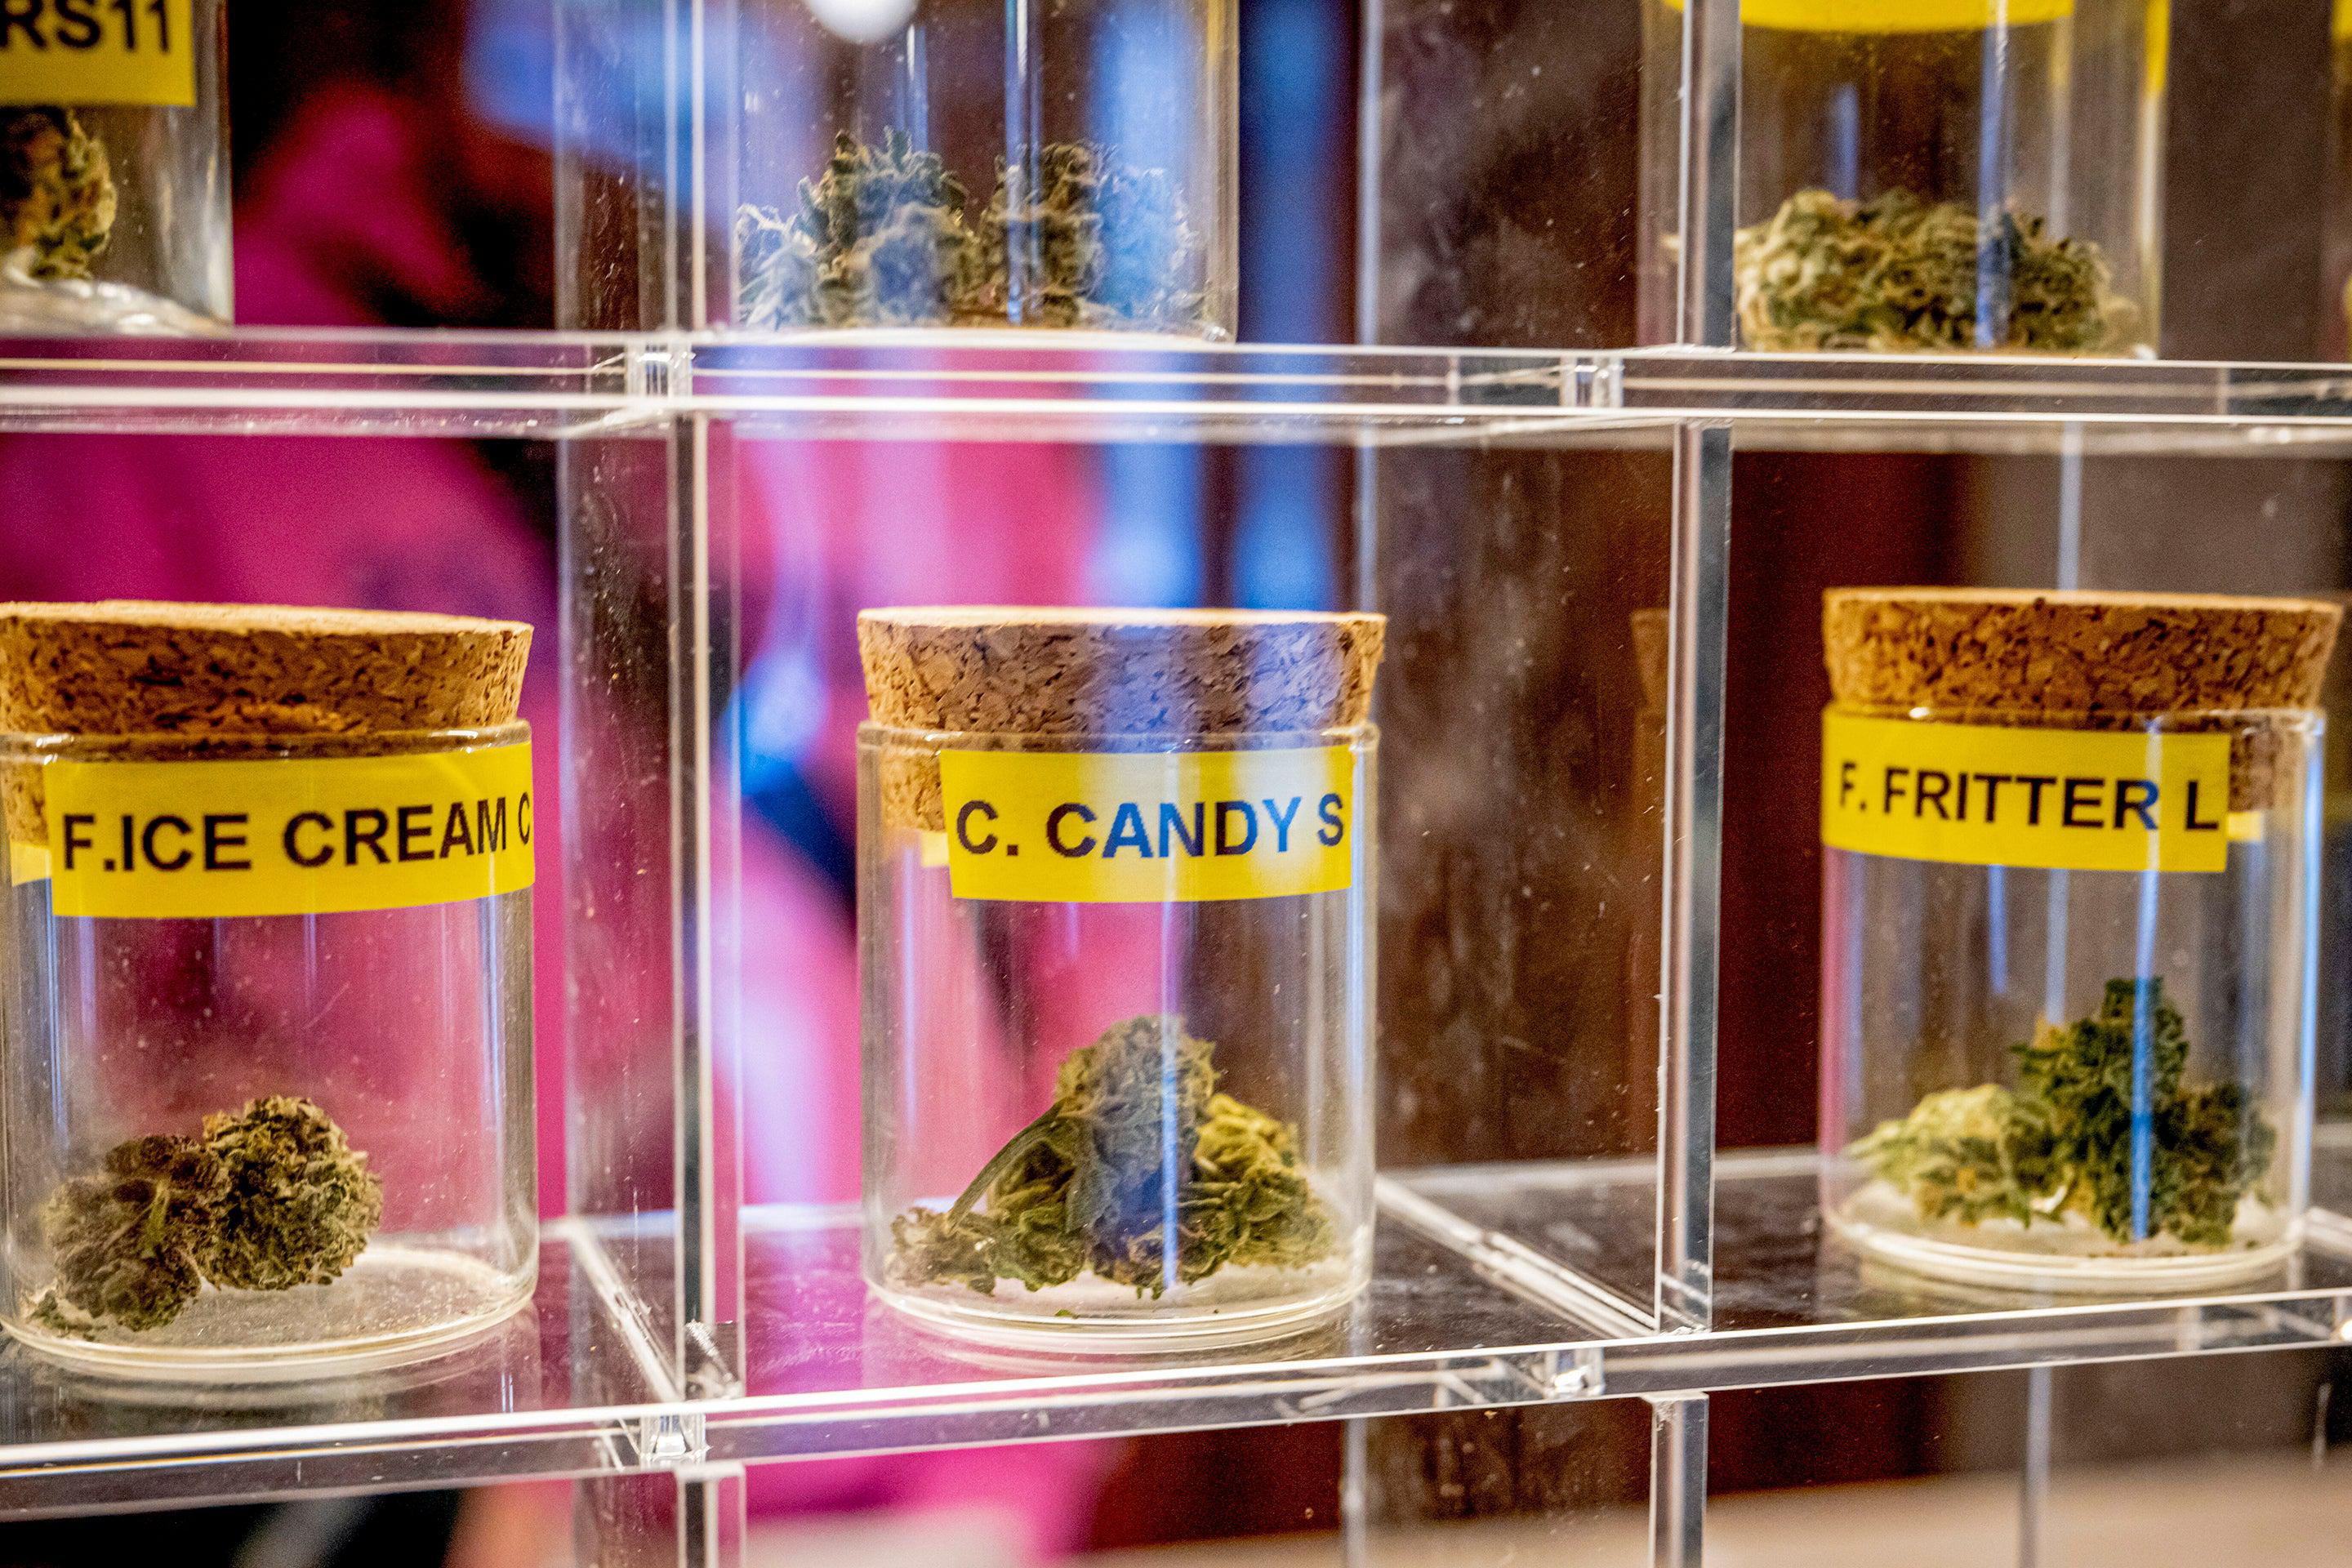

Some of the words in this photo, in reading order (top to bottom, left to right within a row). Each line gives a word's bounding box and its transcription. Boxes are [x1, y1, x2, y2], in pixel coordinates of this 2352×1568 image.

[956, 800, 1019, 856] C.
[1045, 795, 1303, 859] CANDY
[1317, 792, 1344, 847] S
[1840, 760, 1867, 812] F.
[1883, 766, 2159, 831] FRITTER
[2185, 780, 2220, 831] L
[62, 813, 252, 871] F.ICE
[283, 795, 507, 867] CREAM
